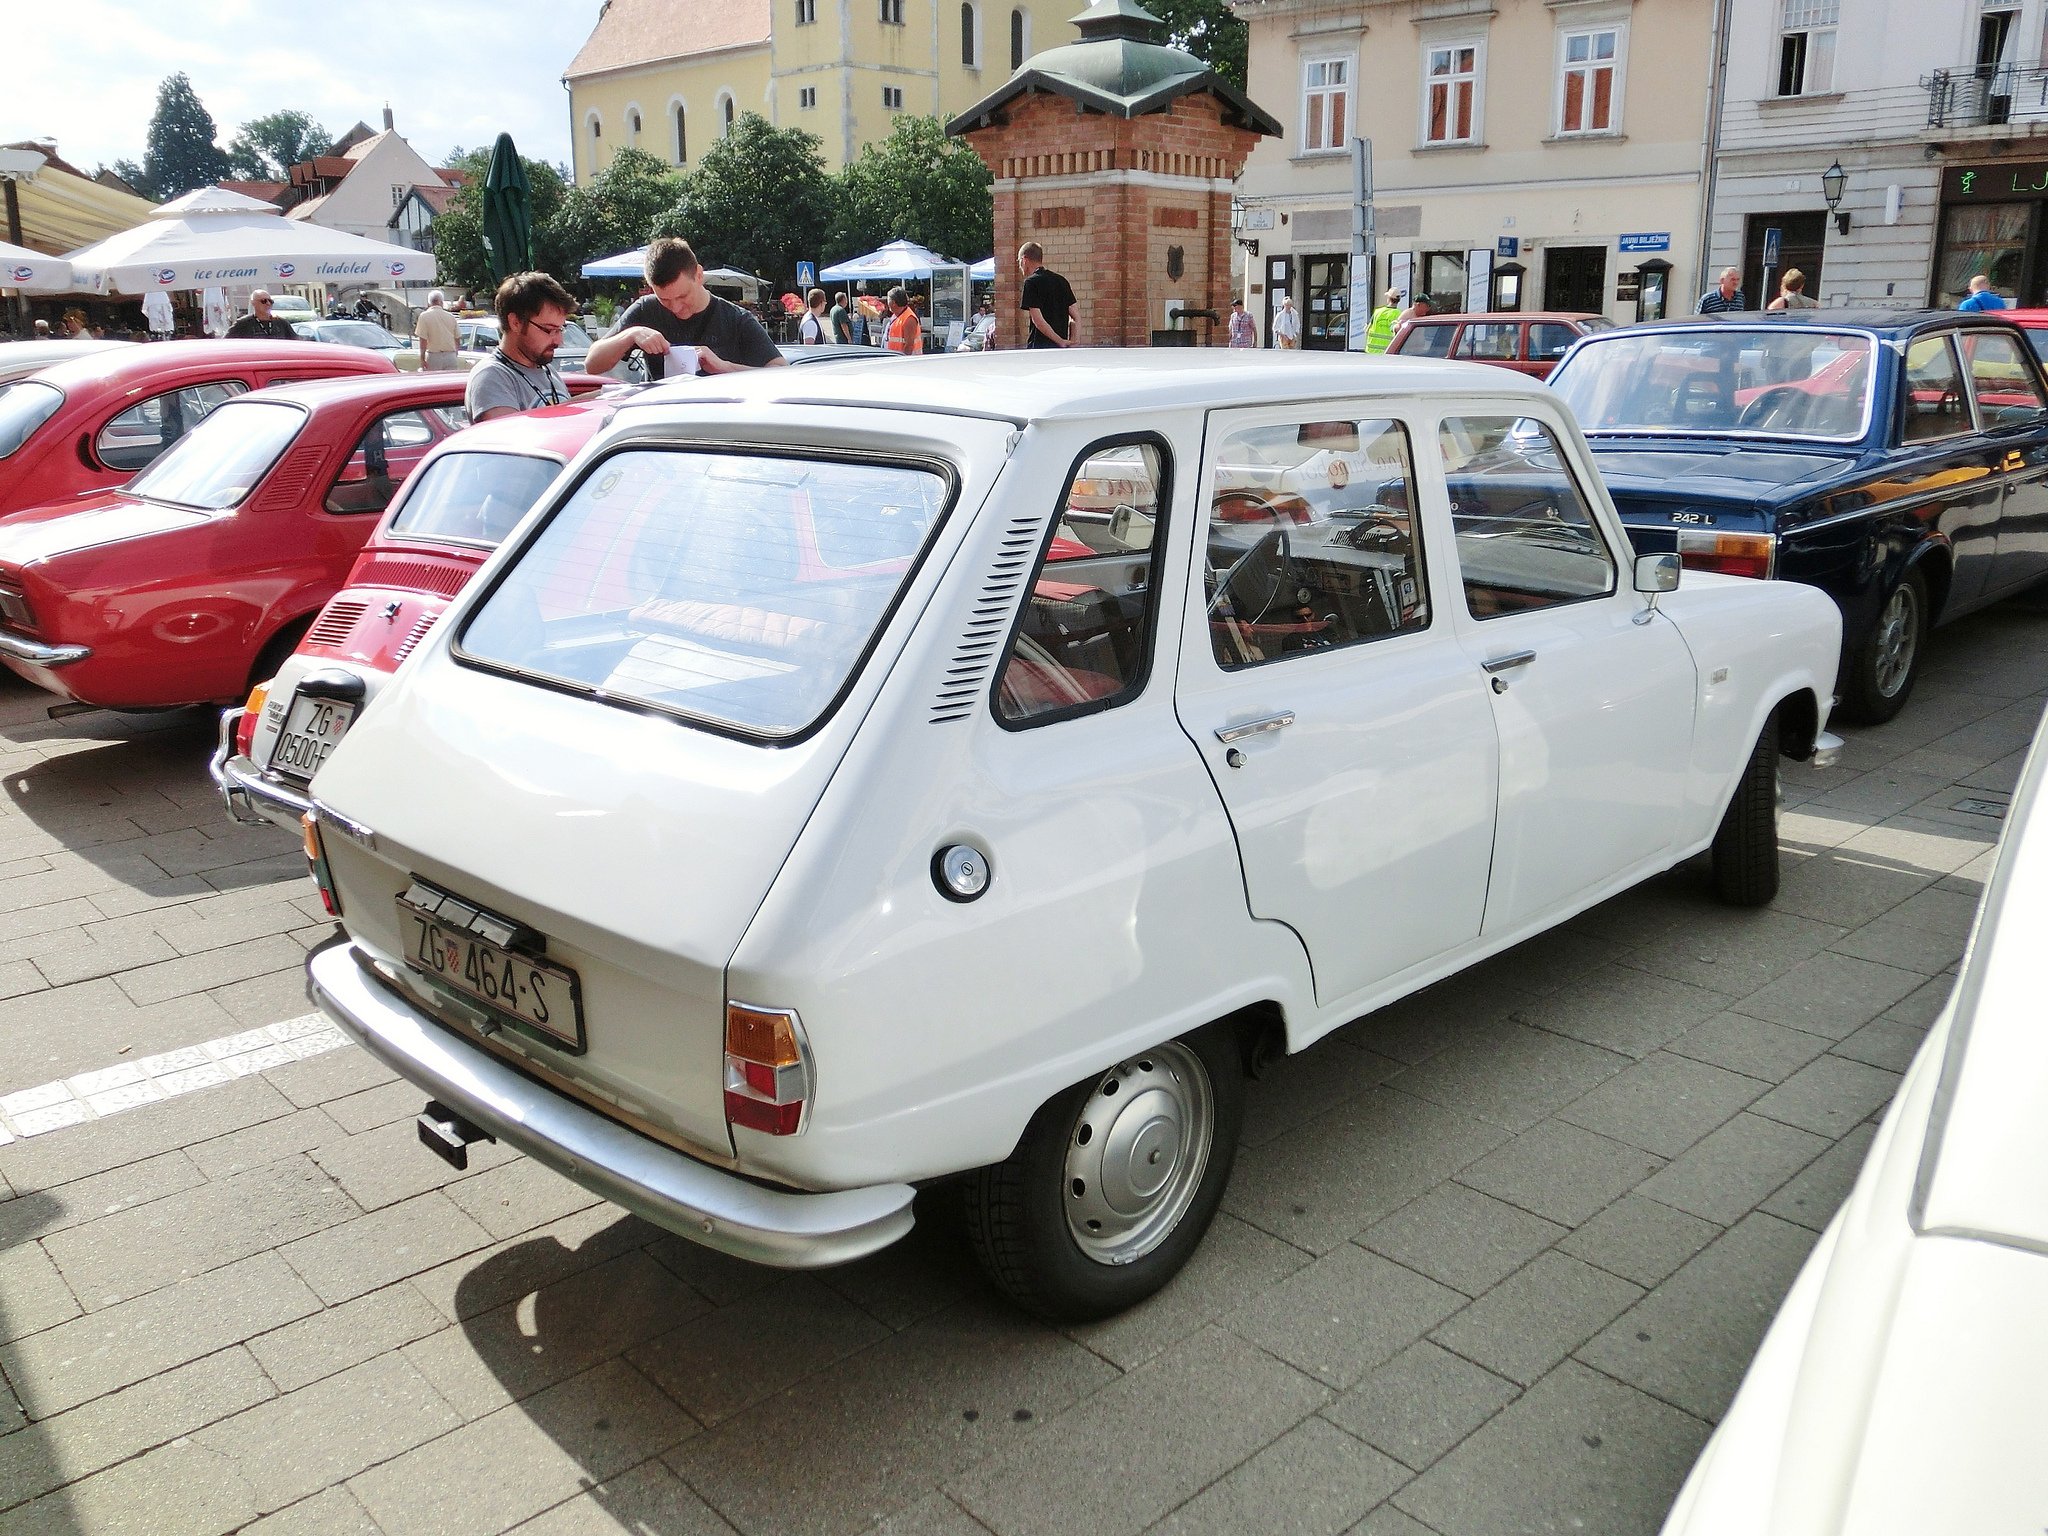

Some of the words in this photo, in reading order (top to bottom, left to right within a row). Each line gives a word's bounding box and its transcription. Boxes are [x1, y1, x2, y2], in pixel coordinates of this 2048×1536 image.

[194, 268, 212, 280] ice
[215, 267, 258, 279] cream
[316, 261, 372, 275] sladoled
[1672, 512, 1700, 524] 242
[1705, 514, 1713, 525] L
[305, 703, 334, 736] ZG
[278, 732, 337, 772] 0500-F
[413, 916, 445, 973] ZG
